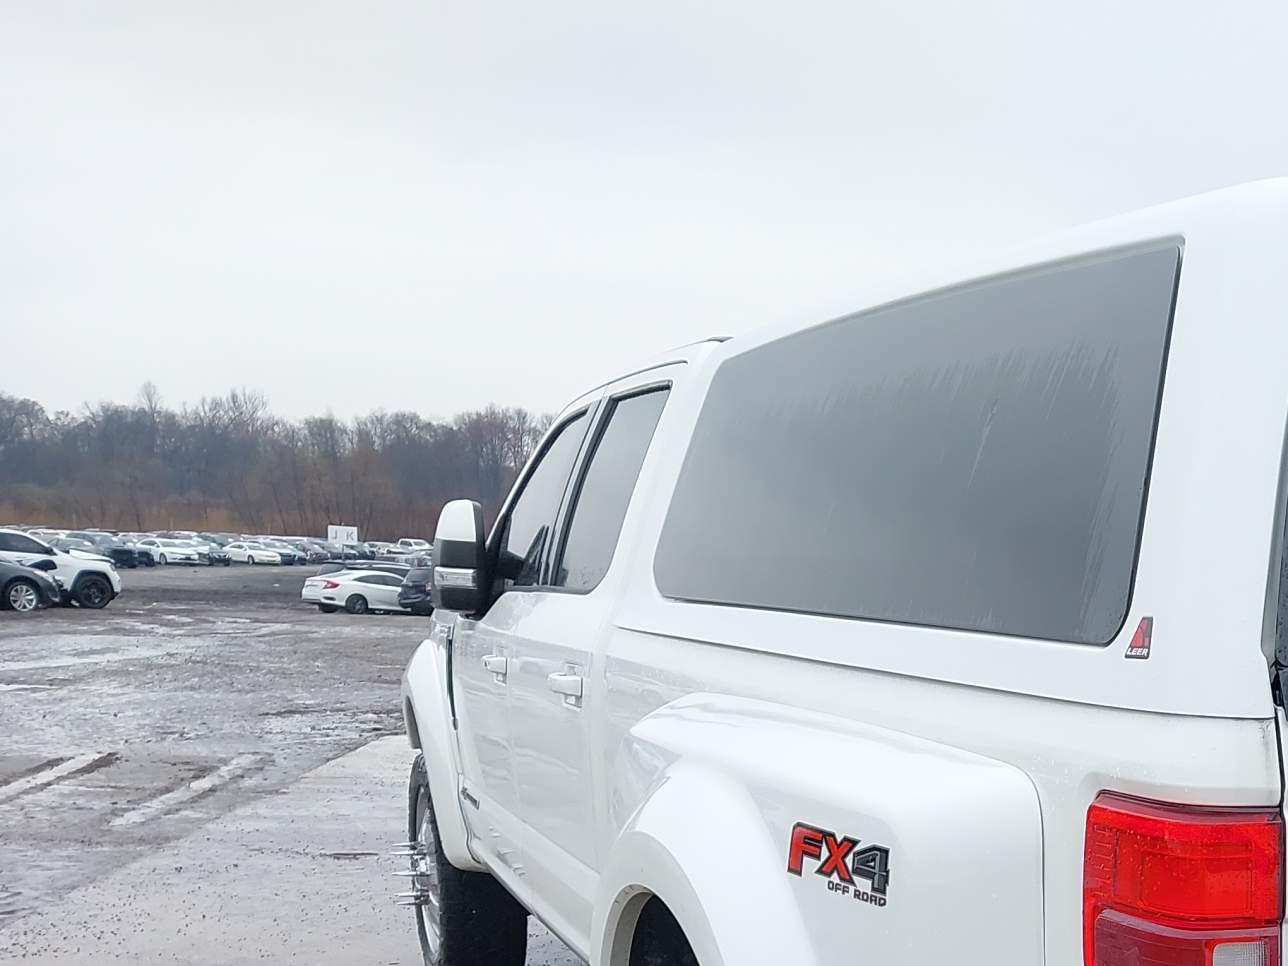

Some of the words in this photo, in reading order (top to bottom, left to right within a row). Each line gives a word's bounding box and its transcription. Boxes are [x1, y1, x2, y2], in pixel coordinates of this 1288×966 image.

[1126, 647, 1149, 657] LEER
[787, 821, 890, 896] FX4
[827, 880, 850, 896] OFF
[853, 888, 887, 907] ROAD
